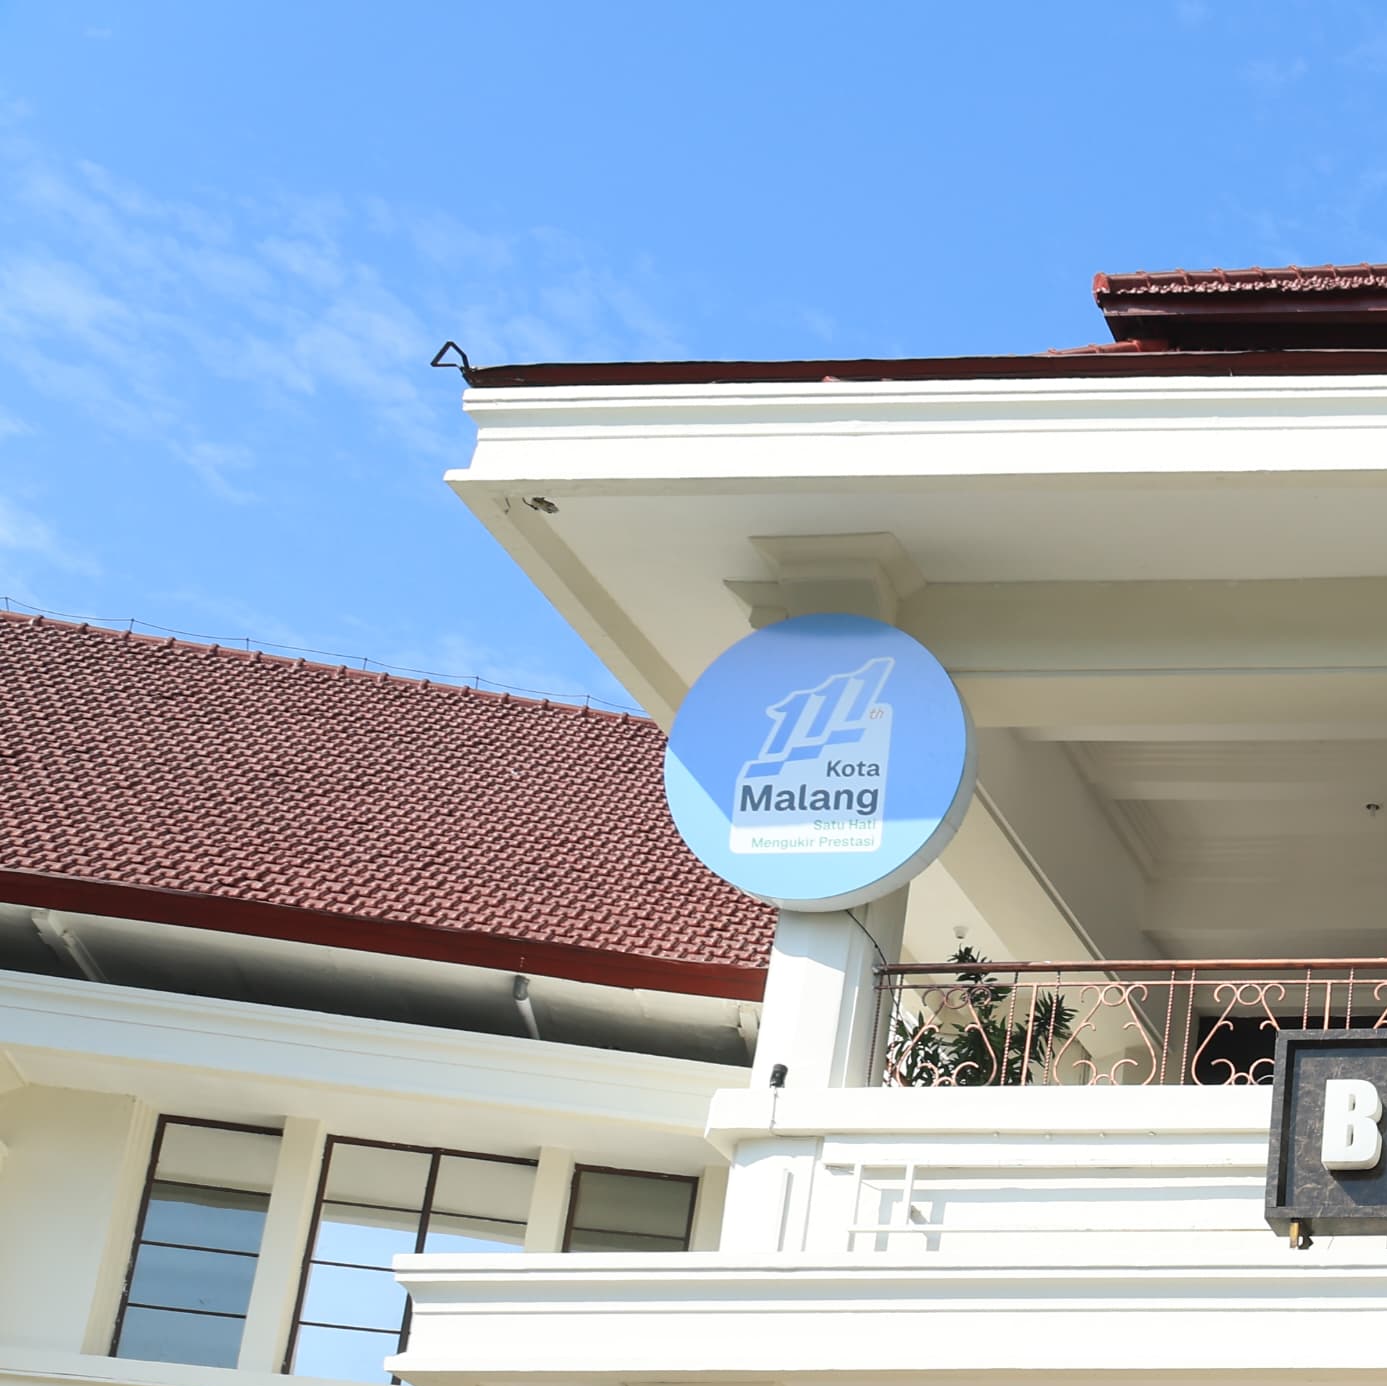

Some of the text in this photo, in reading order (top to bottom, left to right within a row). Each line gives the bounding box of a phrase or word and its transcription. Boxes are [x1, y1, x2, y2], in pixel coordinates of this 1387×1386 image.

[826, 760, 881, 778] Kota
[740, 784, 879, 816] Malang
[814, 819, 877, 831] Satu Hati
[752, 836, 875, 850] Mengukir Prestasi
